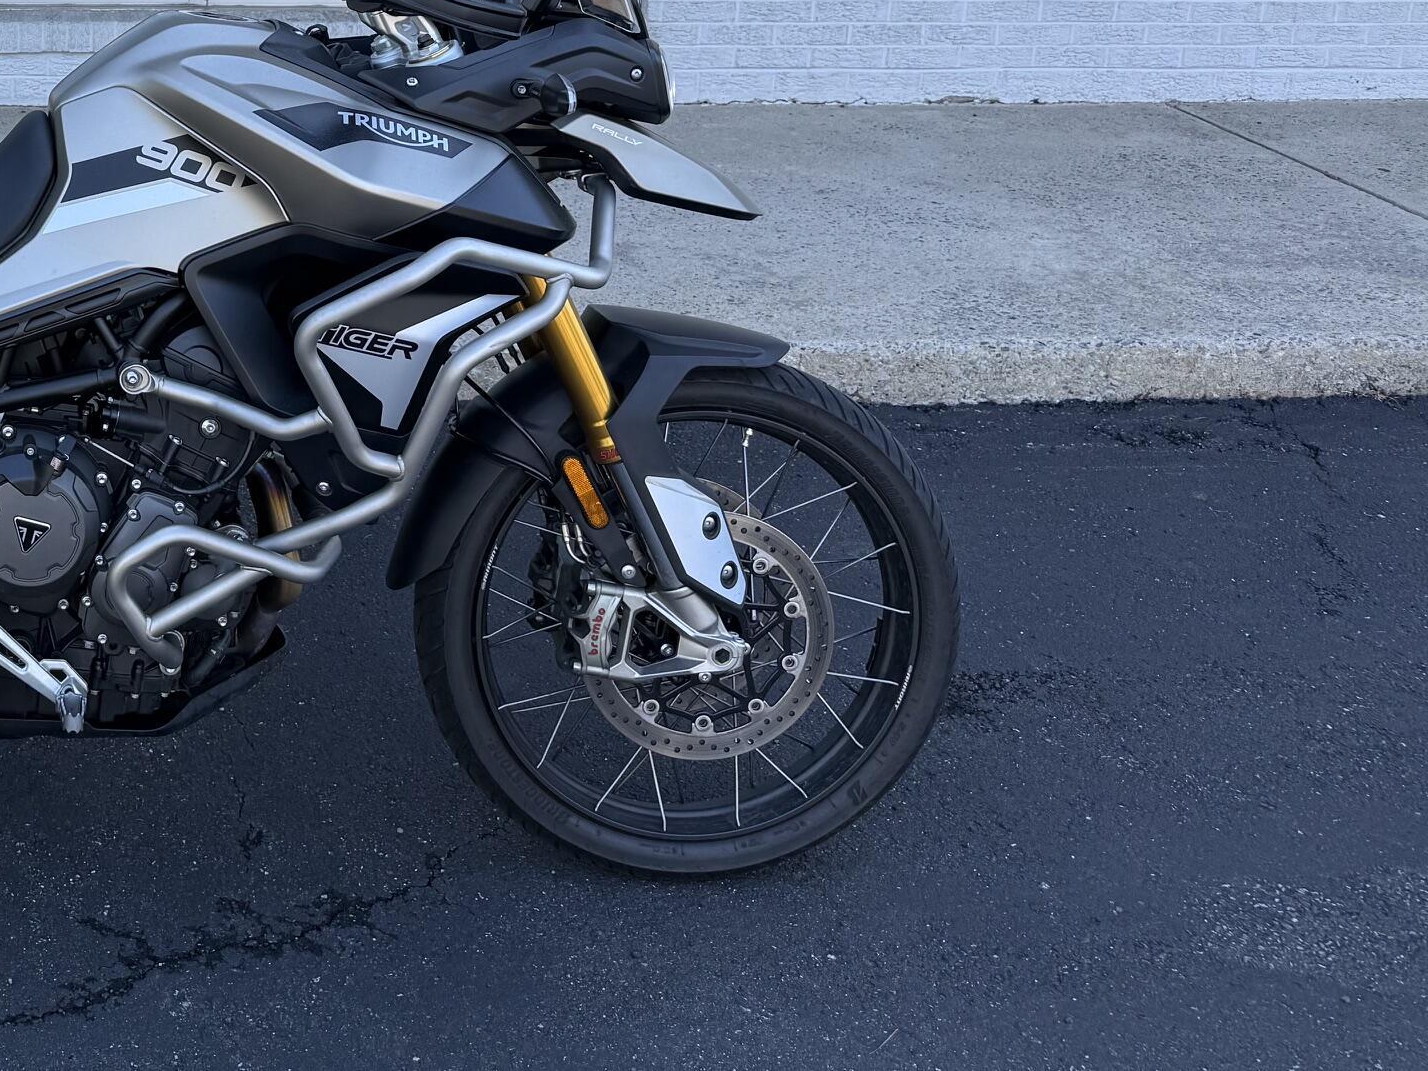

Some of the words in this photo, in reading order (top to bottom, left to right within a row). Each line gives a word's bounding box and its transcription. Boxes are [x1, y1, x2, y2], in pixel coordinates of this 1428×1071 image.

[337, 111, 449, 152] TRIUMPH
[592, 123, 643, 146] RALLY
[135, 137, 245, 193] 900
[588, 607, 606, 656] brembo
